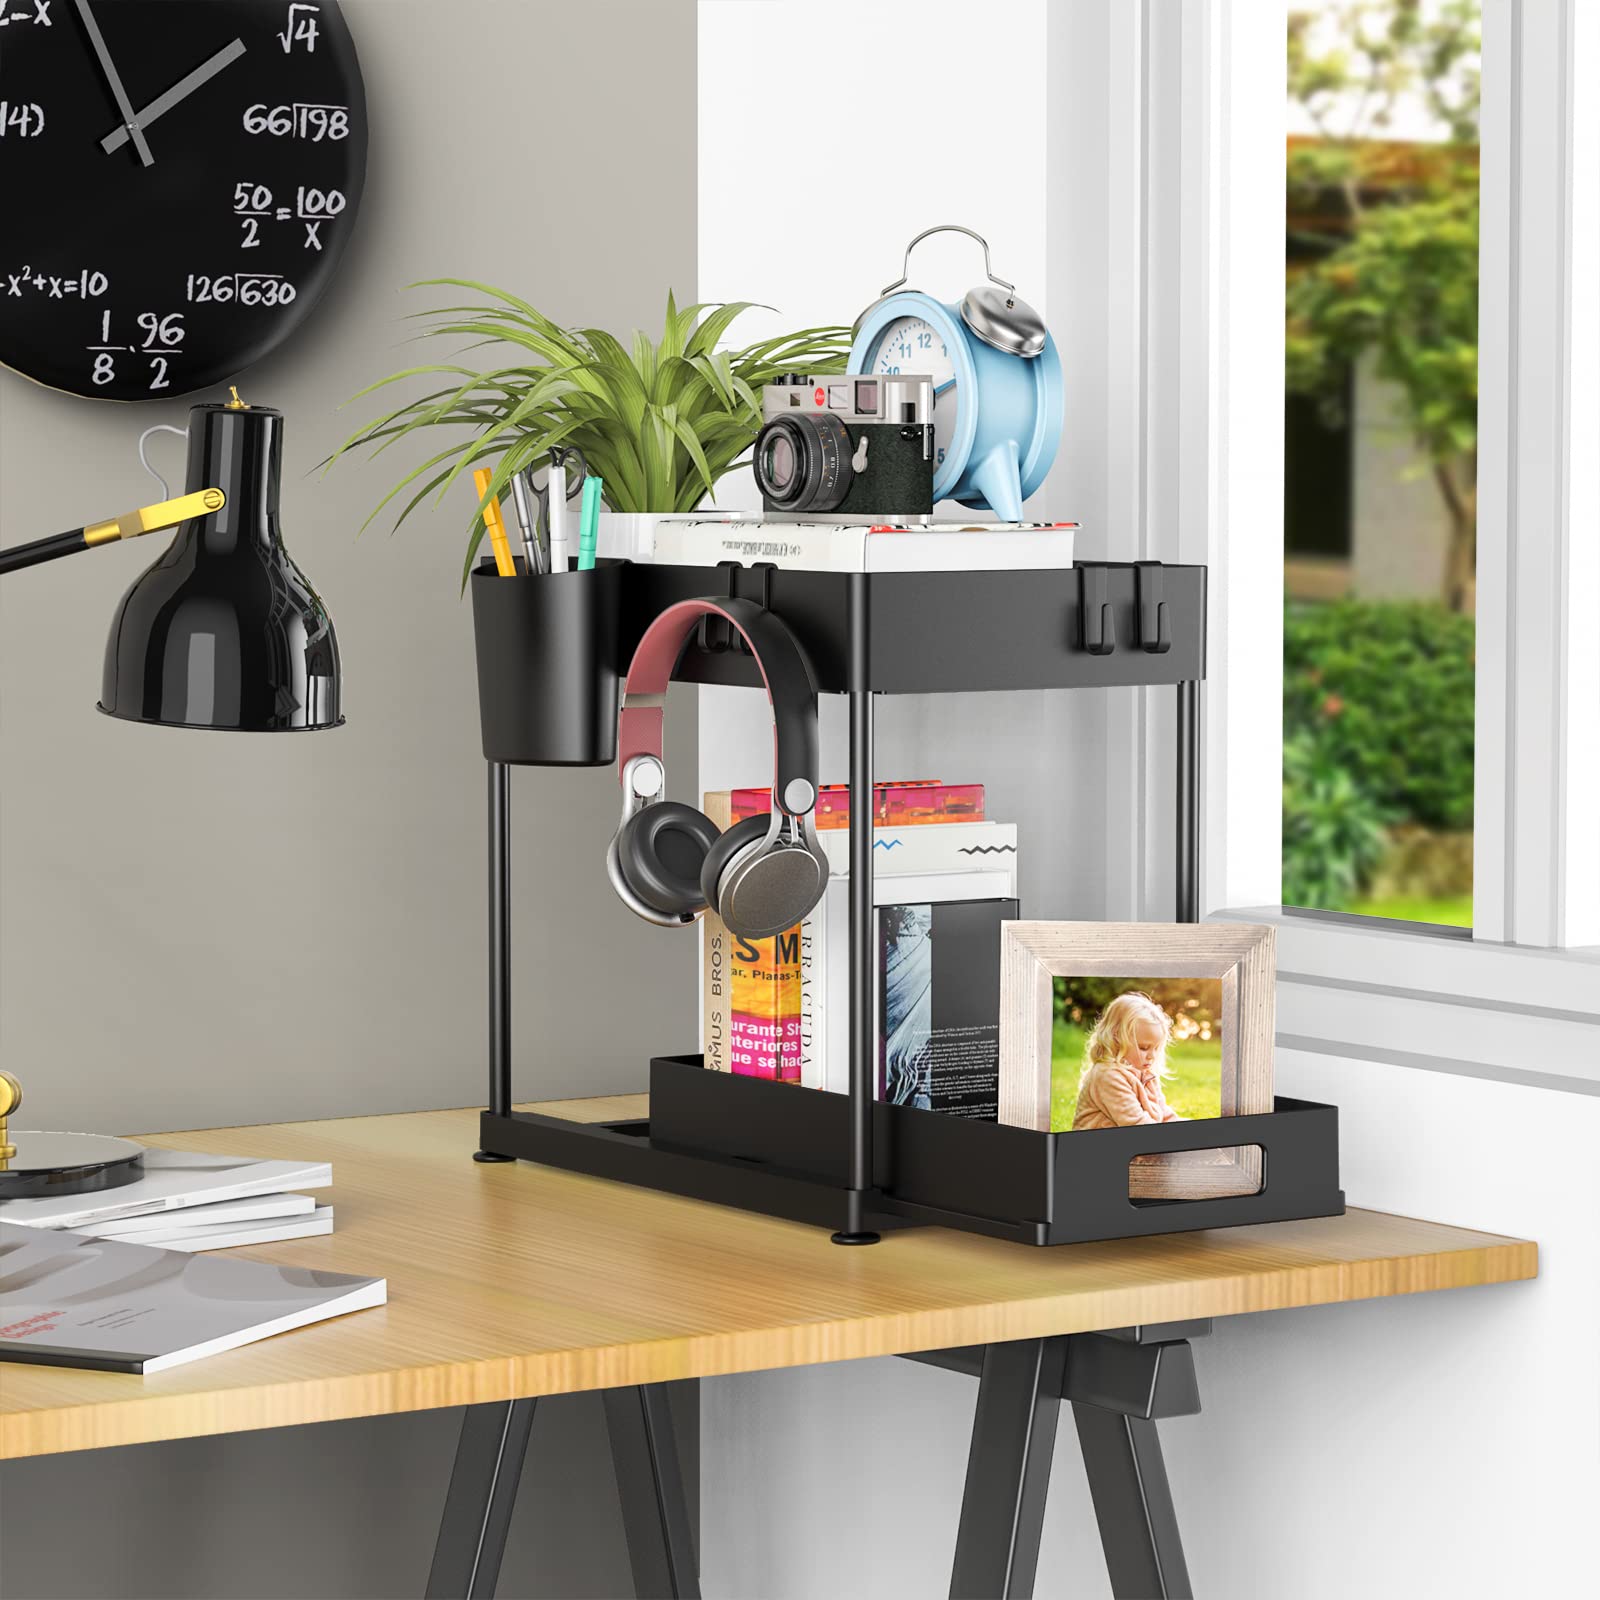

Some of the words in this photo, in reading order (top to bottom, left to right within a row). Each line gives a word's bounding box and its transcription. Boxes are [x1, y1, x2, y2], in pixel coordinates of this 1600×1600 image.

[917, 332, 932, 349] 12
[898, 343, 912, 358] 11
[941, 343, 947, 358] 1
[937, 447, 945, 465] 5
[711, 933, 722, 996] BROS.
[757, 1056, 777, 1069] se
